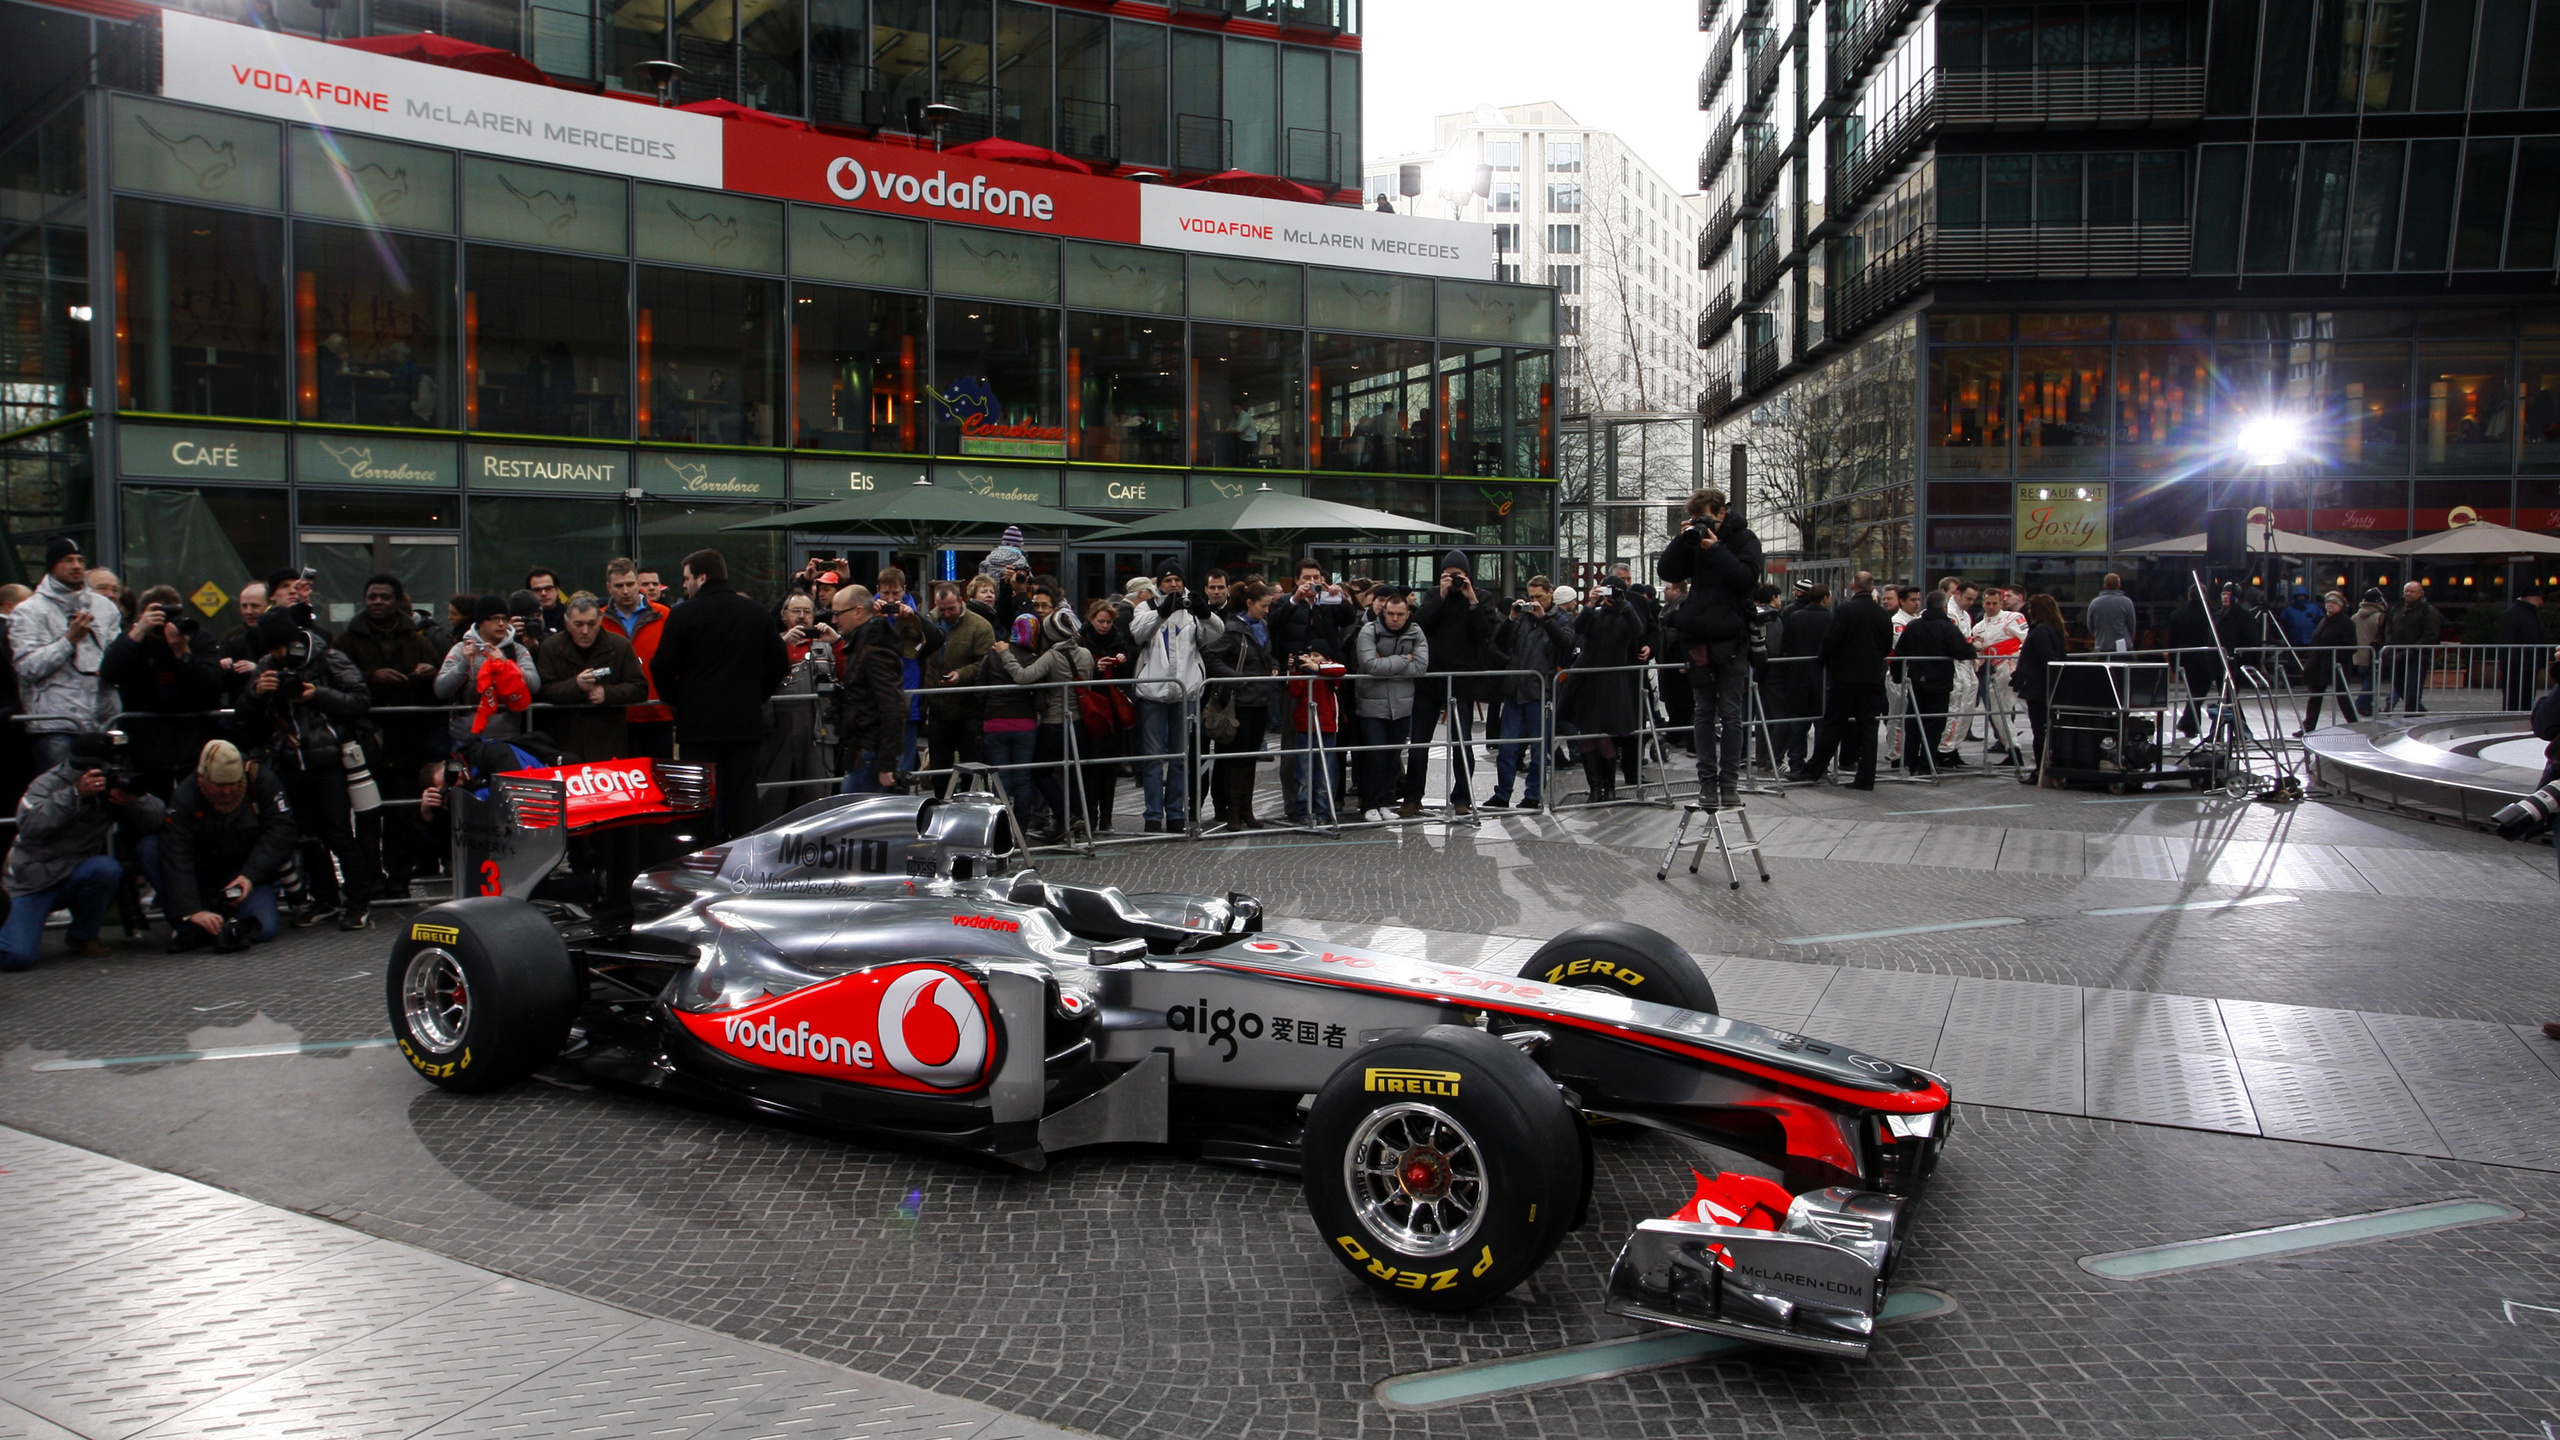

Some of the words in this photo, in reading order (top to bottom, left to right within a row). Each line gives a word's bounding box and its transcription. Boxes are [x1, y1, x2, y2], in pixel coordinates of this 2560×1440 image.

[231, 64, 389, 113] VODAFONE
[406, 98, 532, 136] McLAREN
[544, 122, 676, 160] MERCEDES
[870, 169, 1054, 221] vodafone
[1179, 217, 1273, 240] VODAFONE
[1283, 228, 1364, 250] McLAREN
[1371, 238, 1460, 260] MERCEDES
[961, 412, 1067, 440] Corroboree
[172, 441, 239, 467] CAFÉ
[484, 455, 615, 481] RESTAURANT
[350, 461, 437, 482] Corroboree
[689, 475, 760, 494] Corroboree
[850, 471, 874, 490] EIS
[1107, 482, 1147, 500] CAFÉ
[551, 765, 649, 799] afone
[777, 833, 855, 870] Mobil
[480, 859, 501, 897] 3
[908, 861, 935, 874] BOSS
[757, 872, 866, 896] Mercedes-Benz
[411, 924, 459, 945] PIRELLI
[952, 914, 1019, 933] vodafone
[1545, 958, 1645, 986] ZERO
[725, 1015, 874, 1068] vodafone
[1166, 998, 1264, 1063] aigo
[1271, 1016, 1347, 1050] 爱国者
[398, 1039, 456, 1078] ZERO
[1364, 1067, 1462, 1097] PIRELLI
[1336, 1235, 1459, 1291] ZERO
